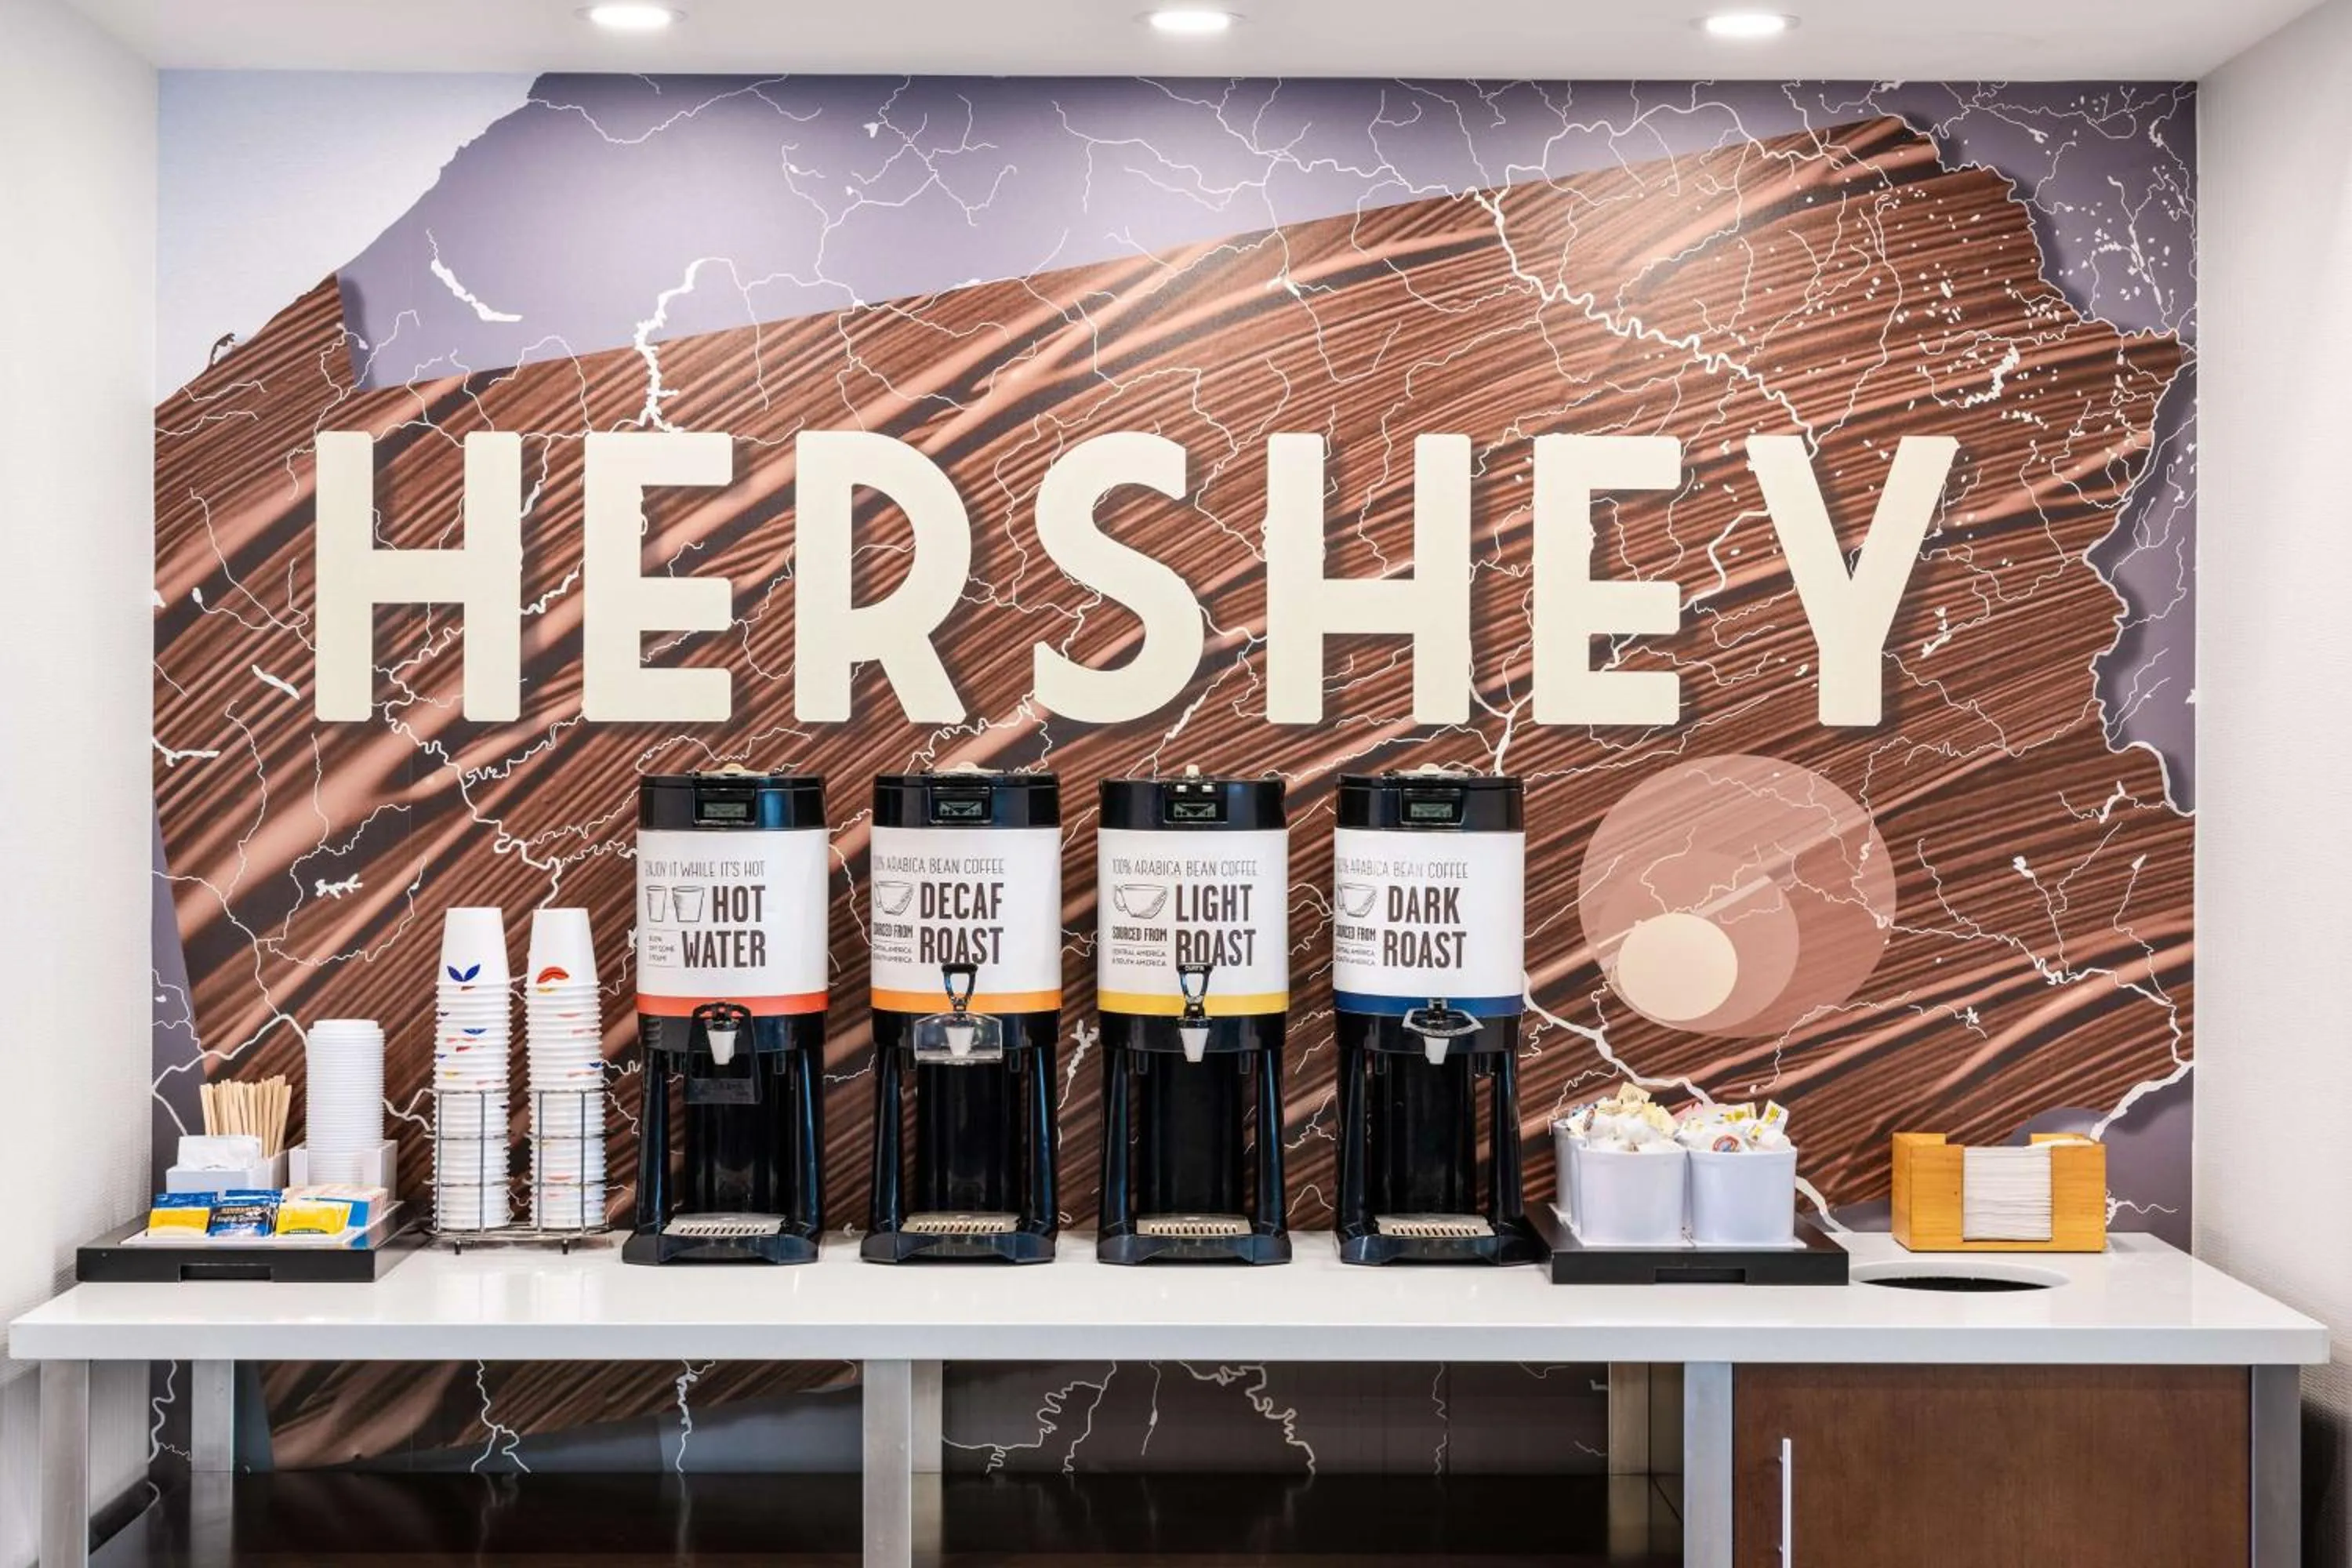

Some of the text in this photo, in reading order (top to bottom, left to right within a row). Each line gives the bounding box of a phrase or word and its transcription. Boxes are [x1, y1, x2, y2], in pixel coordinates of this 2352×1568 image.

[316, 430, 1960, 726] HERSHEY
[669, 861, 677, 877] IT
[680, 861, 715, 877] WHILE
[720, 861, 740, 877] IT'S
[744, 861, 765, 877] HOT
[887, 857, 926, 873] ARABICA
[929, 858, 960, 874] BEAN
[964, 858, 1004, 874] COFFEE
[1134, 860, 1181, 876] ARABICA
[1186, 861, 1217, 877] BEAN
[1221, 861, 1258, 877] COFFEE
[1393, 862, 1423, 878] BEAN
[1428, 862, 1468, 878] COFFEE
[713, 885, 765, 923] HOT
[920, 882, 1004, 919] DECAF
[1176, 884, 1253, 922] LIGHT
[1388, 885, 1461, 924] DARK
[682, 930, 765, 968] WATER
[893, 924, 913, 938] FROM
[920, 926, 1004, 964] ROAST
[1144, 927, 1168, 942] FROM
[1176, 929, 1257, 967] ROAST
[1357, 927, 1376, 941] FROM
[1383, 930, 1467, 968] ROAST
